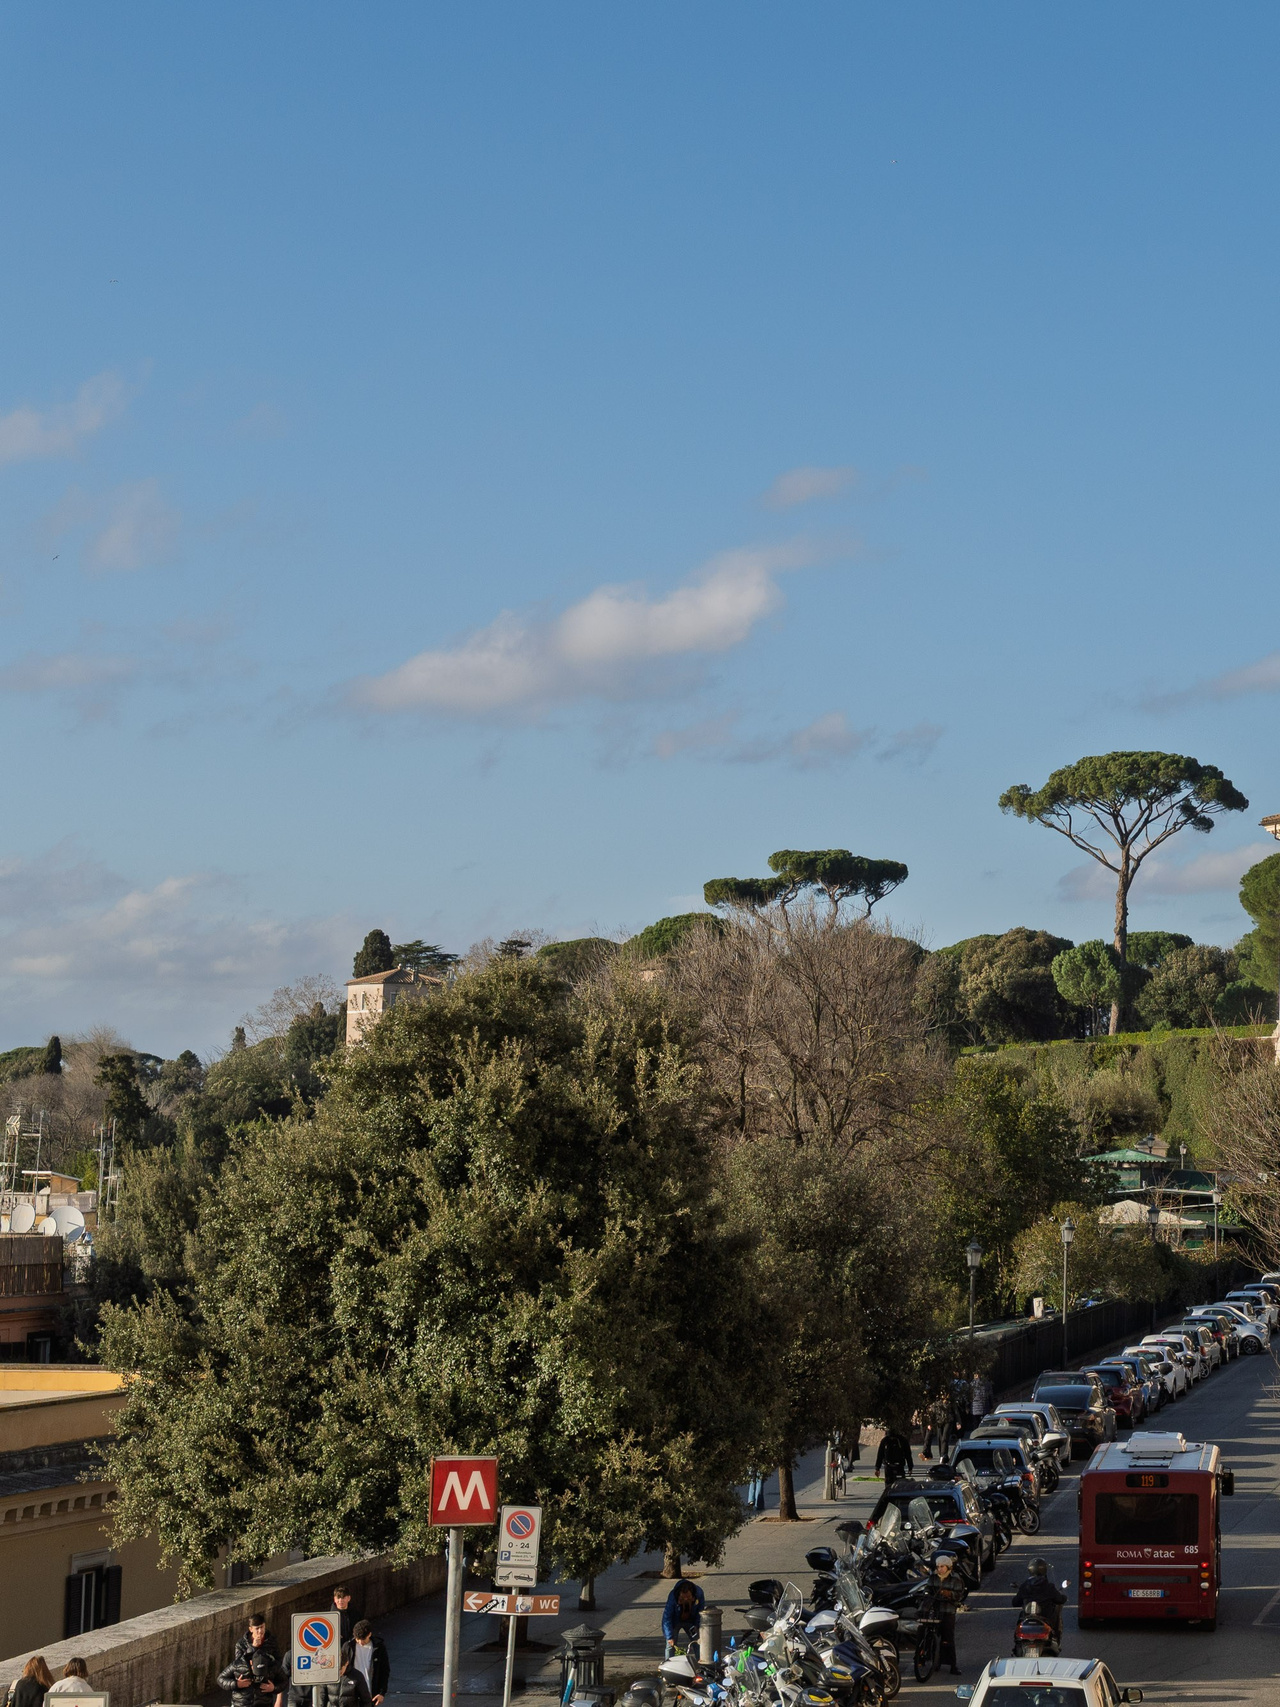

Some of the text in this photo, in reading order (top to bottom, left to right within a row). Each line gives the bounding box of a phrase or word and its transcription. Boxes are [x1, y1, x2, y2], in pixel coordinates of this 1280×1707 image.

[1141, 1475, 1154, 1487] 119
[437, 1470, 491, 1511] M
[1116, 1549, 1175, 1558] ROMA atac
[1184, 1545, 1199, 1554] 685
[502, 1551, 509, 1560] P
[540, 1599, 559, 1610] WC
[300, 1657, 309, 1669] P
